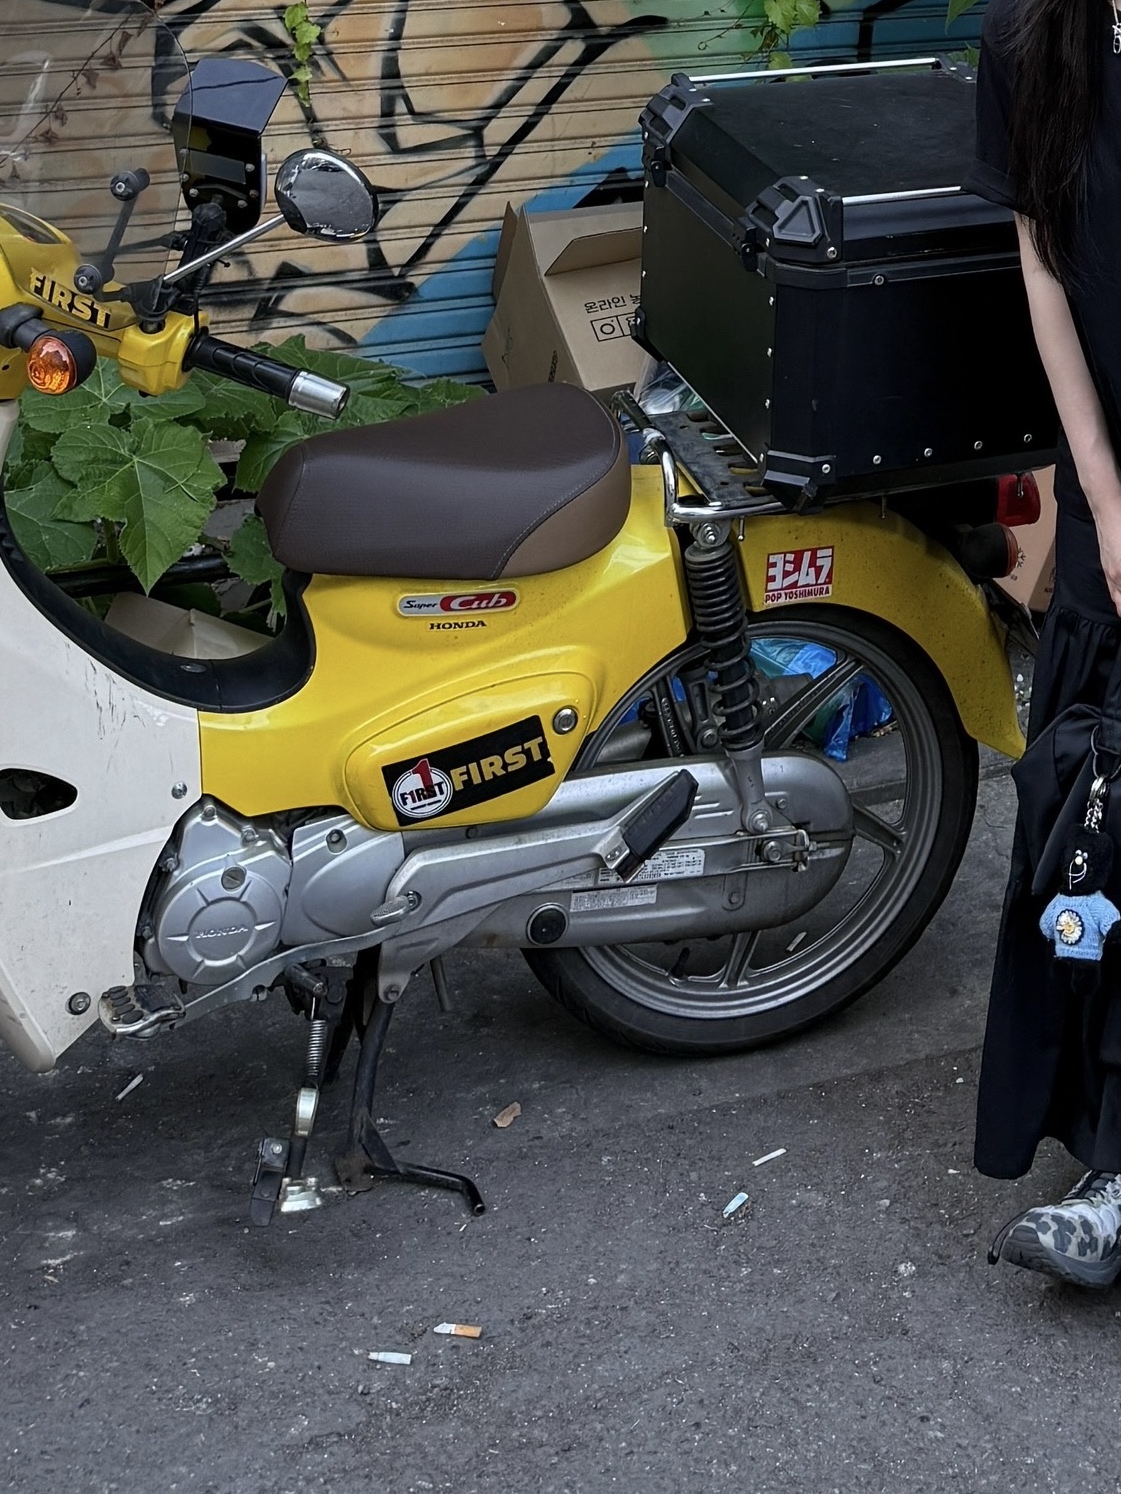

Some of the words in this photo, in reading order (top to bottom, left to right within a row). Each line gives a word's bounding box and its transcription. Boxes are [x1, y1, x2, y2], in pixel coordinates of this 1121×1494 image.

[29, 267, 112, 328] FIRST
[584, 296, 627, 314] 온라인
[767, 548, 833, 590] ヨシムラ
[403, 600, 438, 609] Super
[450, 593, 507, 610] Cub
[765, 592, 783, 604] POP
[784, 586, 830, 601] YOSHIMURA
[429, 620, 487, 630] HONDA
[450, 736, 543, 792] FIRST
